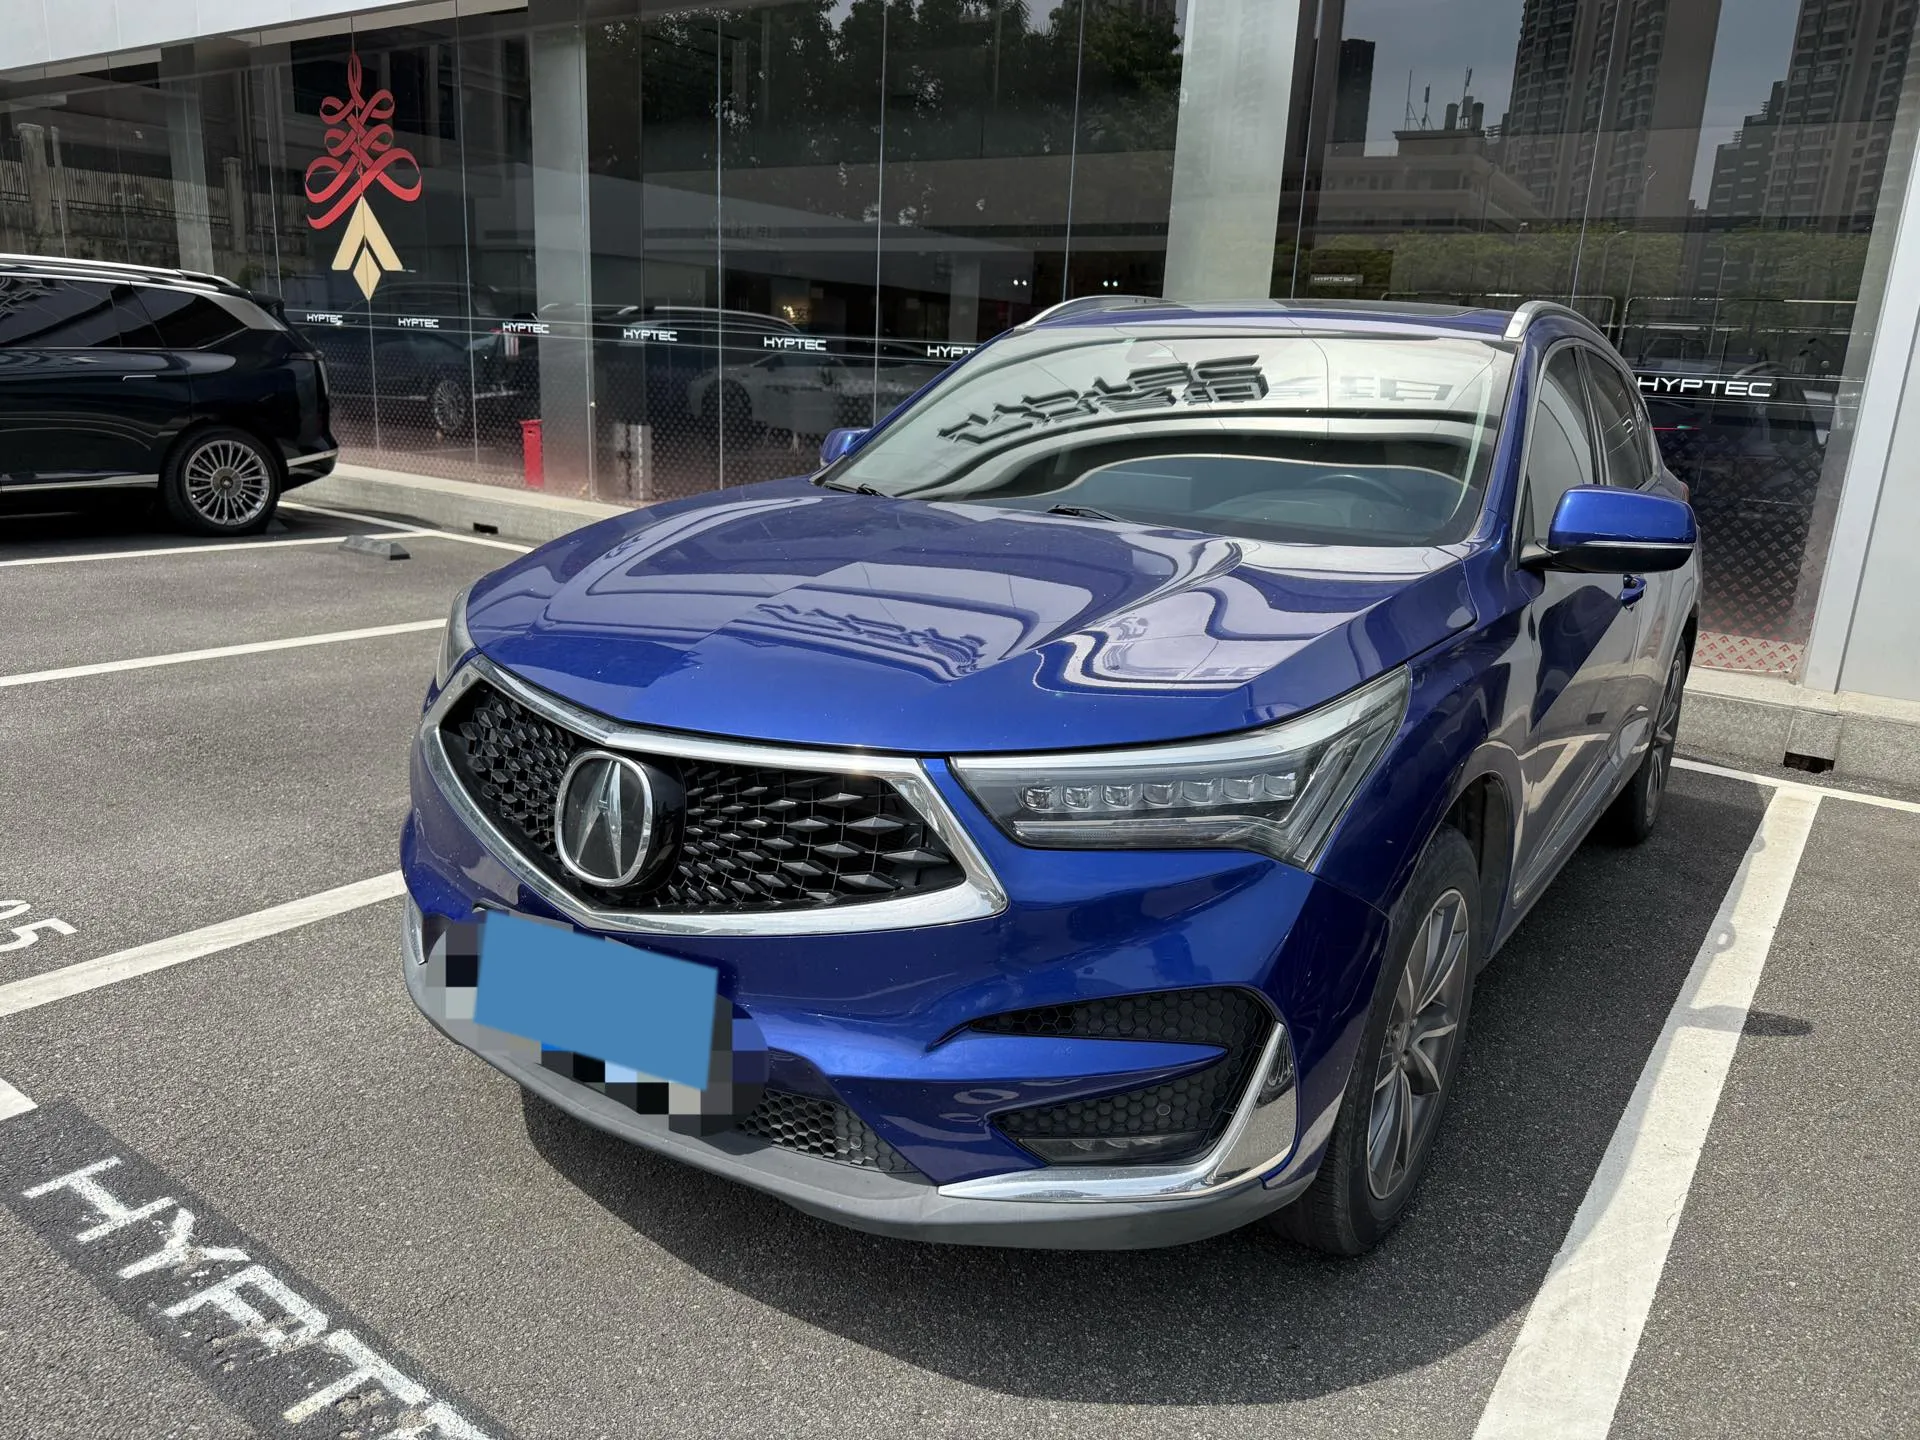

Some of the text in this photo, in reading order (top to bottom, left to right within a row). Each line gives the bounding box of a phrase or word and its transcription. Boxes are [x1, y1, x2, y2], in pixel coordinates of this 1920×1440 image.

[306, 313, 343, 325] HYPTEC
[398, 317, 440, 328] HYPTEC
[502, 322, 550, 334] HYPTEC
[623, 328, 678, 341] HYPTEC
[763, 336, 827, 351] HYPTEC
[1637, 376, 1773, 397] HYPTEC
